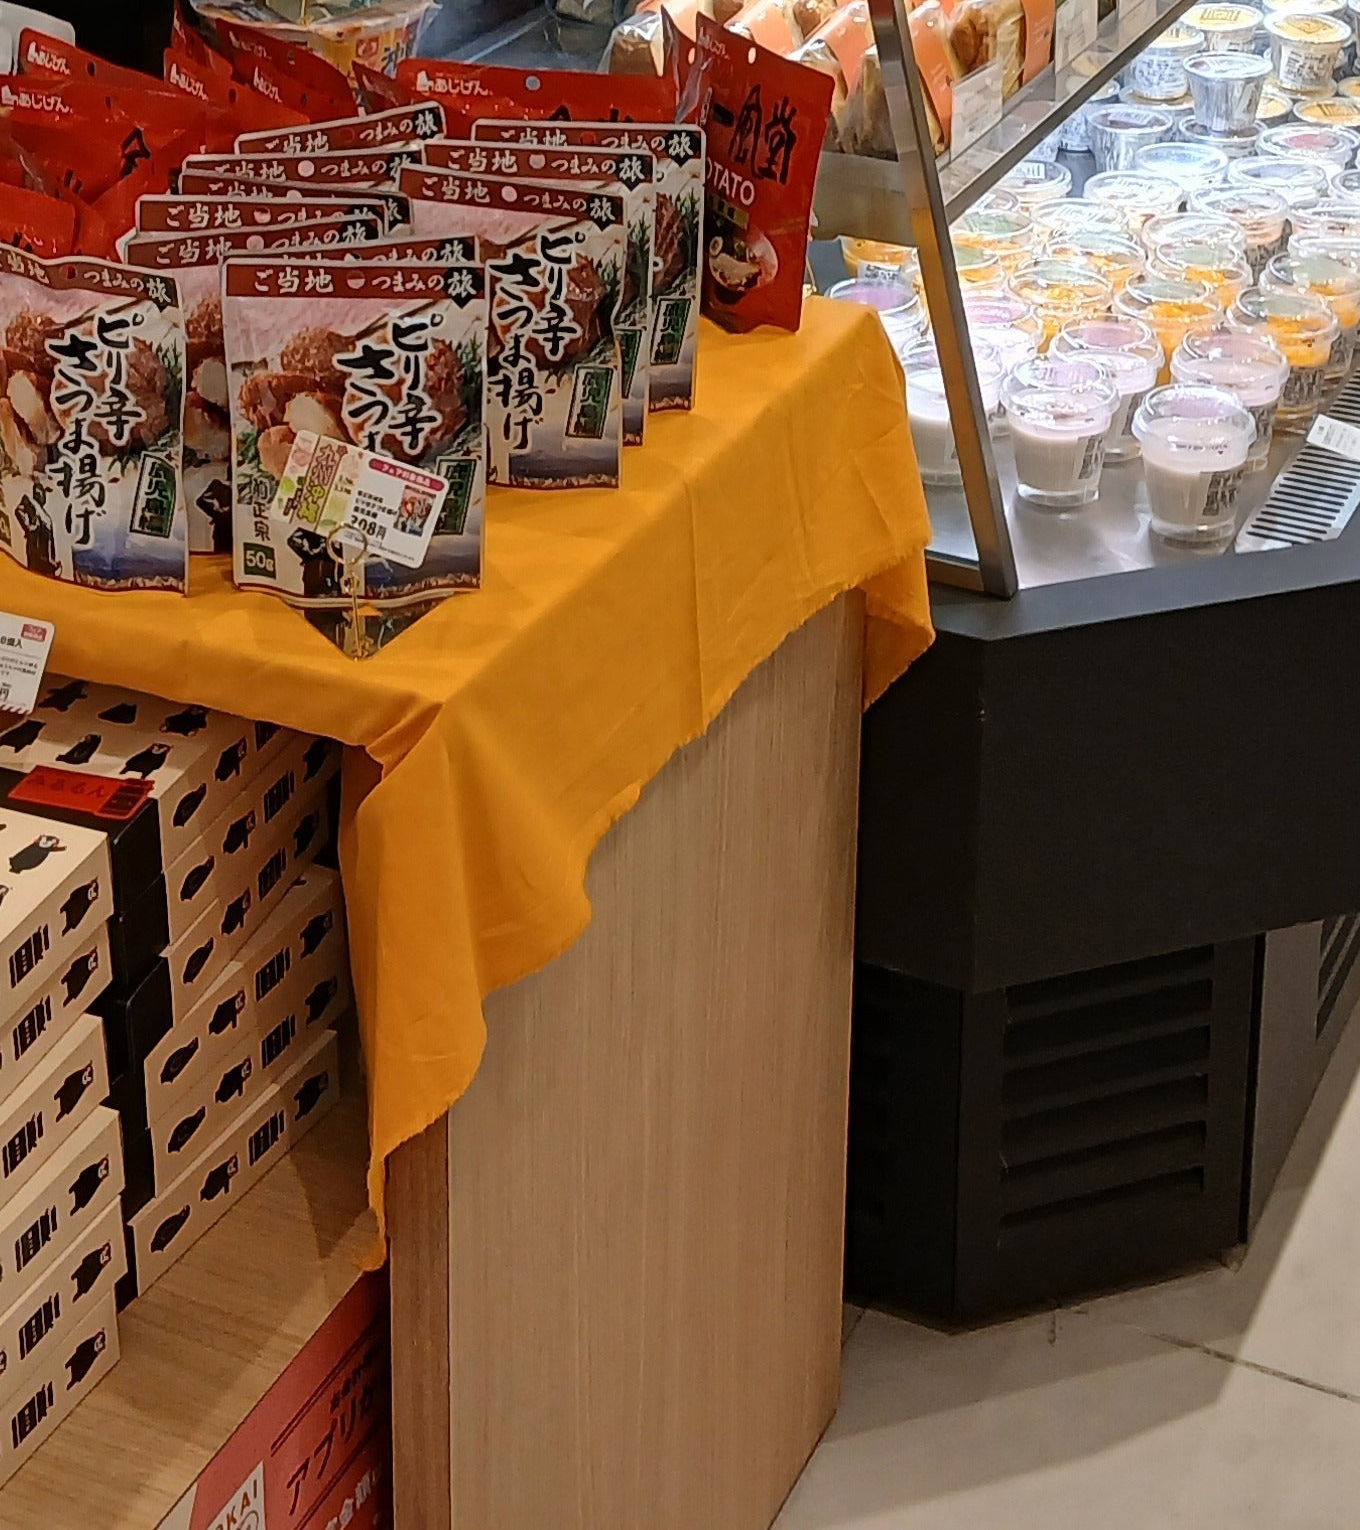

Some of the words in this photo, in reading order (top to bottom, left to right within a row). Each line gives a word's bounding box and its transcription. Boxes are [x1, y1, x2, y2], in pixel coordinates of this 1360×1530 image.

[448, 148, 518, 173] ご当地
[551, 154, 646, 184] つまみの旅
[706, 158, 755, 206] TATO
[165, 204, 242, 228] ご当地
[420, 174, 491, 203] ご当地
[523, 194, 616, 223] つまみの旅
[82, 266, 174, 306] つまみの旅
[253, 268, 335, 296] ご当地
[371, 266, 479, 297] つまみの旅
[535, 230, 586, 361] ピリ辛
[96, 313, 145, 442] ピリ辛
[488, 255, 546, 451] さつま揚げ
[387, 312, 445, 456] ピリ辛
[48, 333, 108, 546] さつま揚げ
